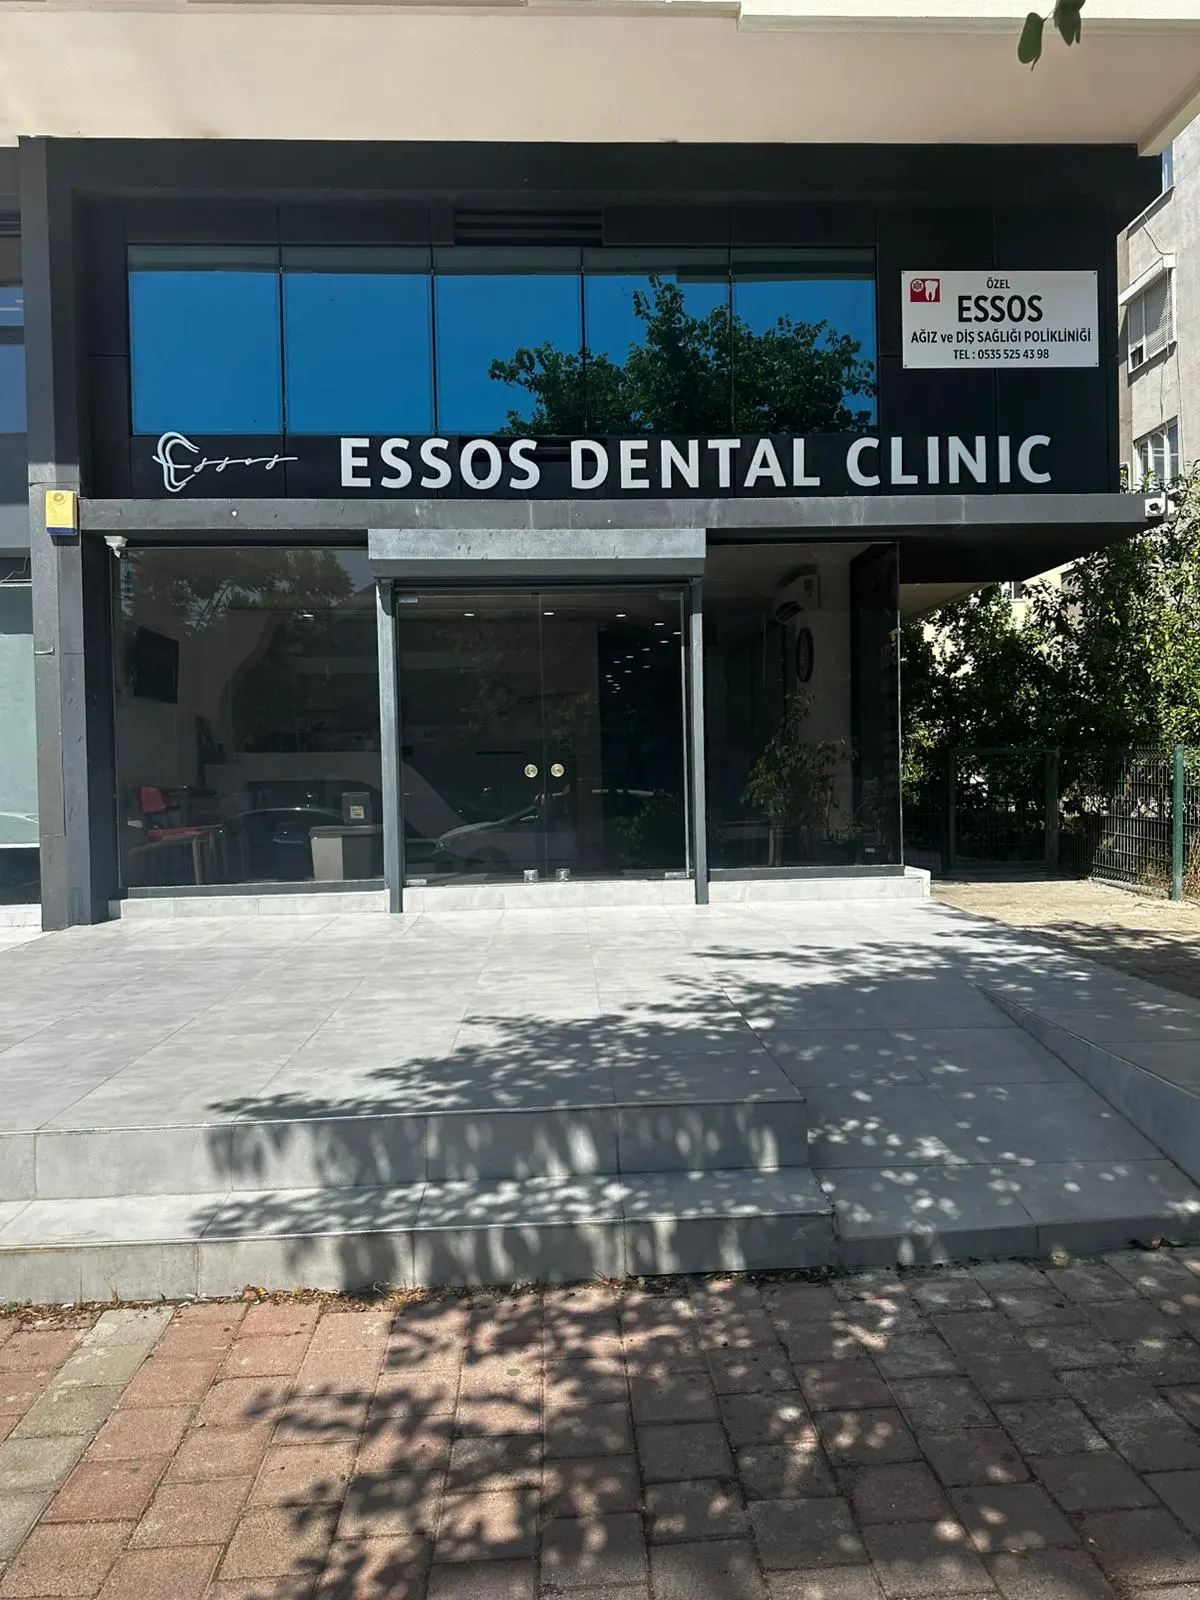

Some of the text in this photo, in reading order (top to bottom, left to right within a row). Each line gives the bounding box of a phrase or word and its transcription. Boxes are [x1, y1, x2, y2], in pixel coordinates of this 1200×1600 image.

[986, 276, 1011, 290] ÖZEL
[957, 294, 1044, 323] ESSOS
[910, 327, 1091, 345] AĞIZ ve DİŞ SAĞLIĞI POLİKLİNİĞİ
[953, 349, 971, 360] TEL
[977, 348, 1002, 360] 0535
[1003, 348, 1021, 360] 525
[1022, 348, 1035, 360] 43
[1036, 348, 1050, 360] 98
[340, 434, 1052, 490] ESSOS DENTAL CLINIC
